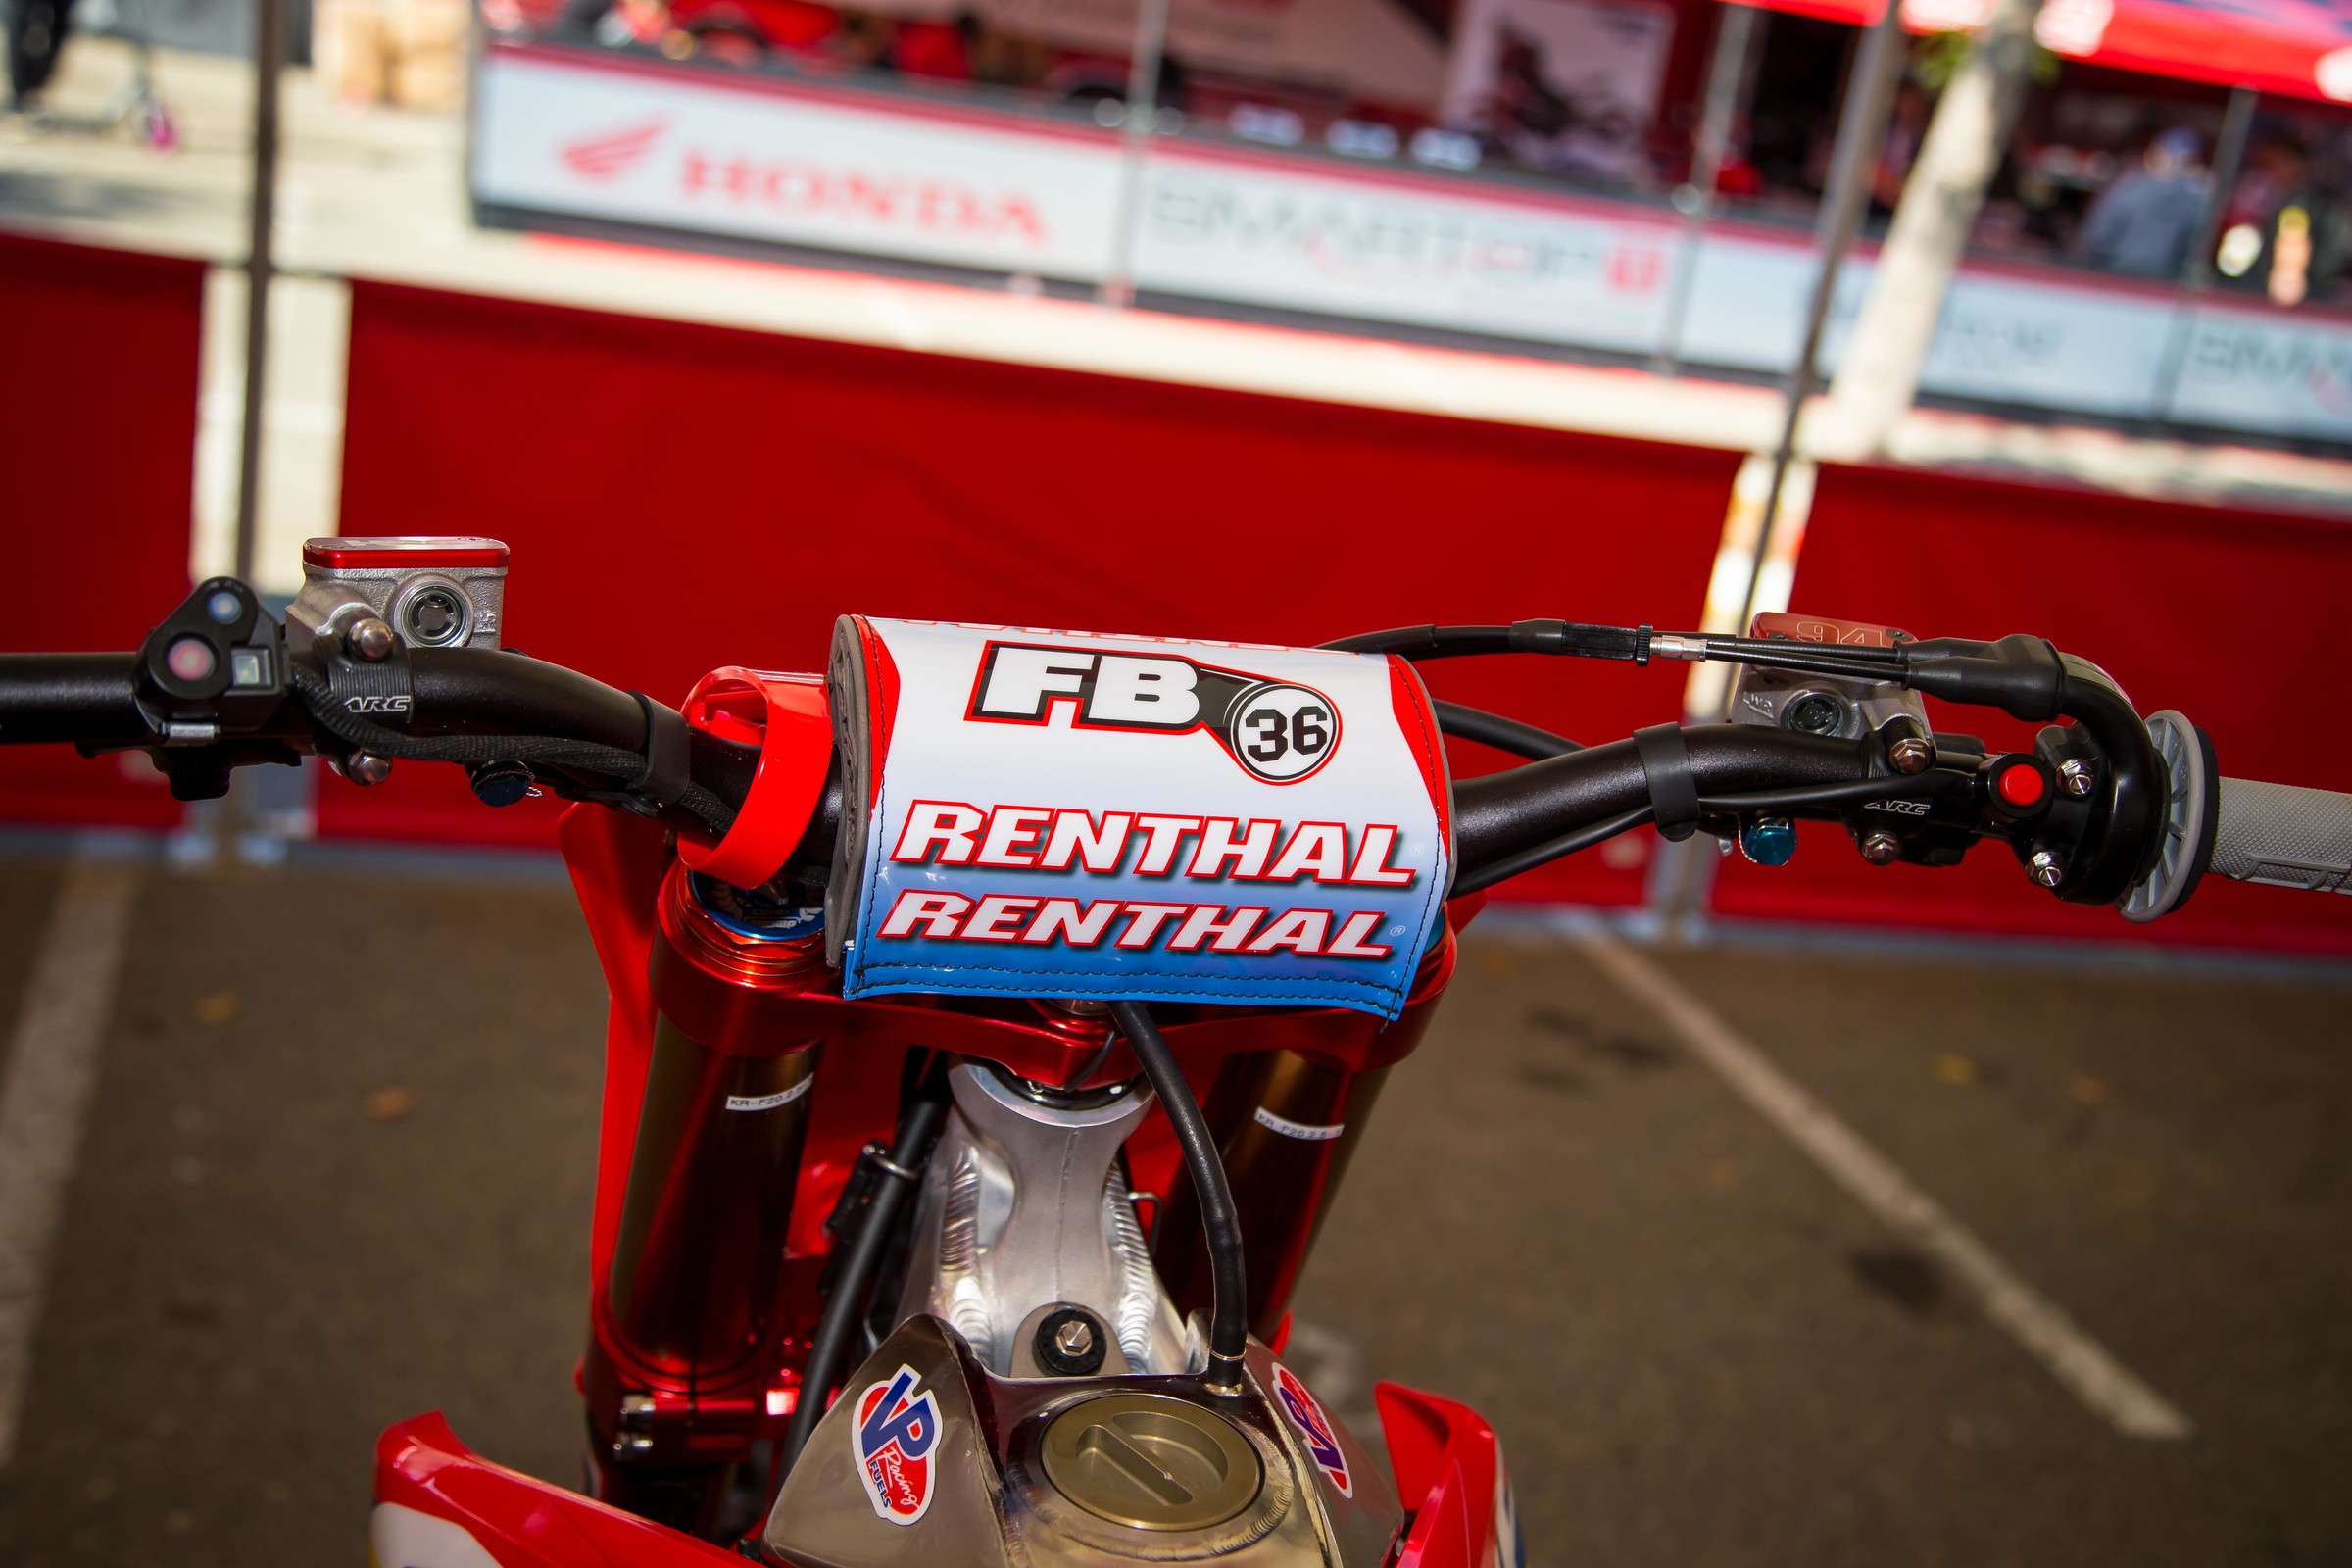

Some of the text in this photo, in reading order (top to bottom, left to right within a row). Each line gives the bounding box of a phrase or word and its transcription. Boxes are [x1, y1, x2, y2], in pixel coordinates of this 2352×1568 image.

[680, 147, 1047, 245] HONDA
[344, 695, 411, 712] ARC
[980, 644, 1329, 763] FB 36
[890, 799, 1416, 887] RENTHAL
[1864, 799, 1930, 815] ARC
[876, 888, 1393, 958] RENTHAL
[861, 1372, 935, 1459] VP
[1279, 1387, 1344, 1470] VP
[869, 1459, 893, 1509] FUELS
[878, 1446, 920, 1510] Racing
